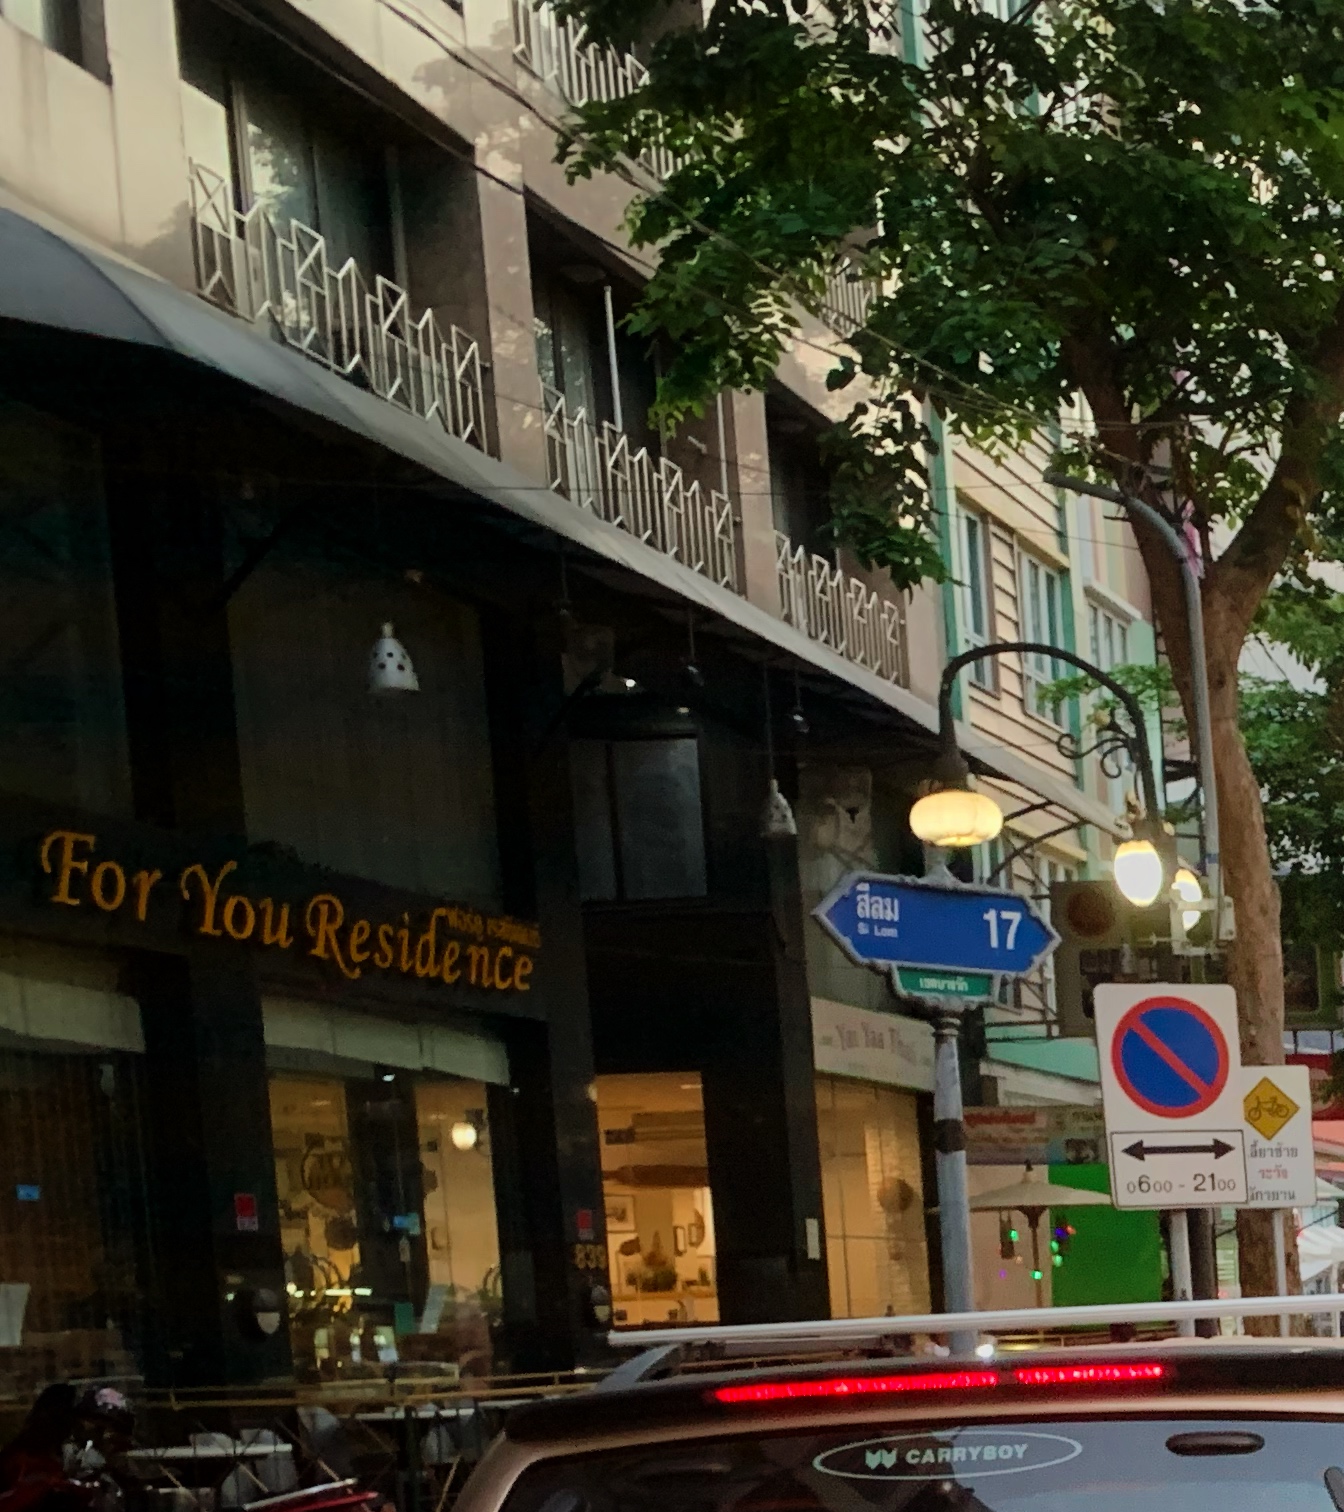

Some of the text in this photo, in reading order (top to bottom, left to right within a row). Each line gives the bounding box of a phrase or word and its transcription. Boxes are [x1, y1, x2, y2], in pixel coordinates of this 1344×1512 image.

[40, 829, 163, 921] For
[180, 860, 295, 949] You
[305, 894, 535, 992] Residence
[856, 882, 1022, 950] สีลม 17
[874, 924, 898, 938] Lom
[905, 1443, 1028, 1465] CARRYBOY
